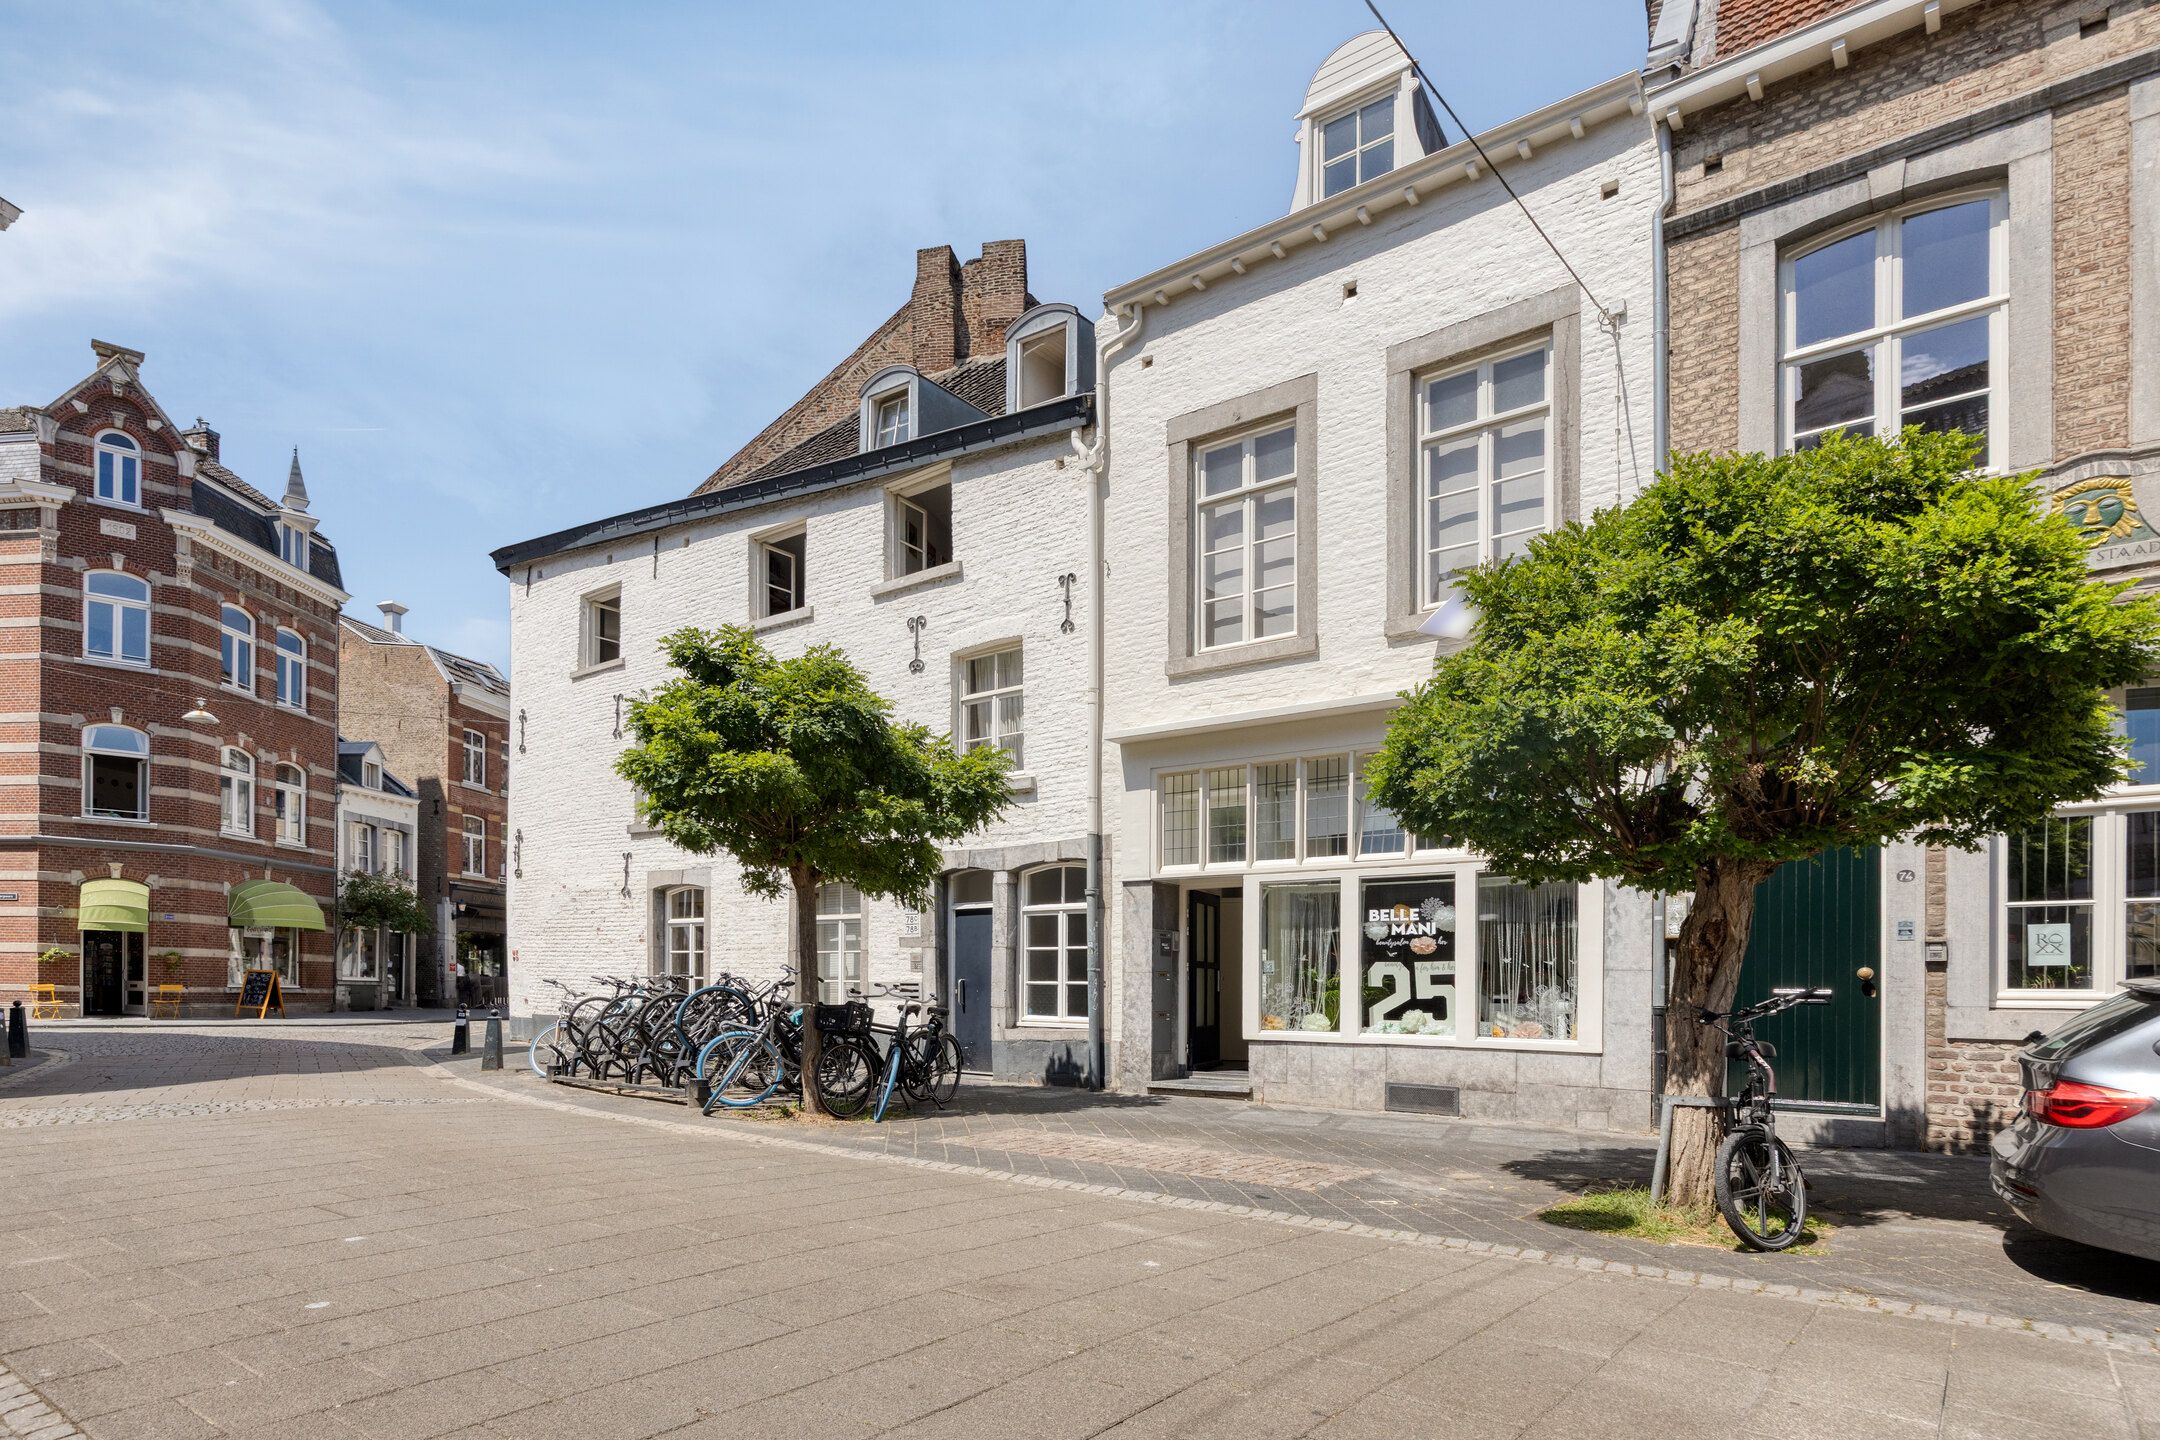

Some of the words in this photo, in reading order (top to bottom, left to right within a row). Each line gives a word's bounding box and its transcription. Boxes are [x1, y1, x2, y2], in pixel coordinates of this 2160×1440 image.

[1899, 872, 1913, 881] 74
[1369, 908, 1420, 922] BELLE
[1391, 922, 1436, 935] MANI
[1368, 961, 1455, 1028] 25
